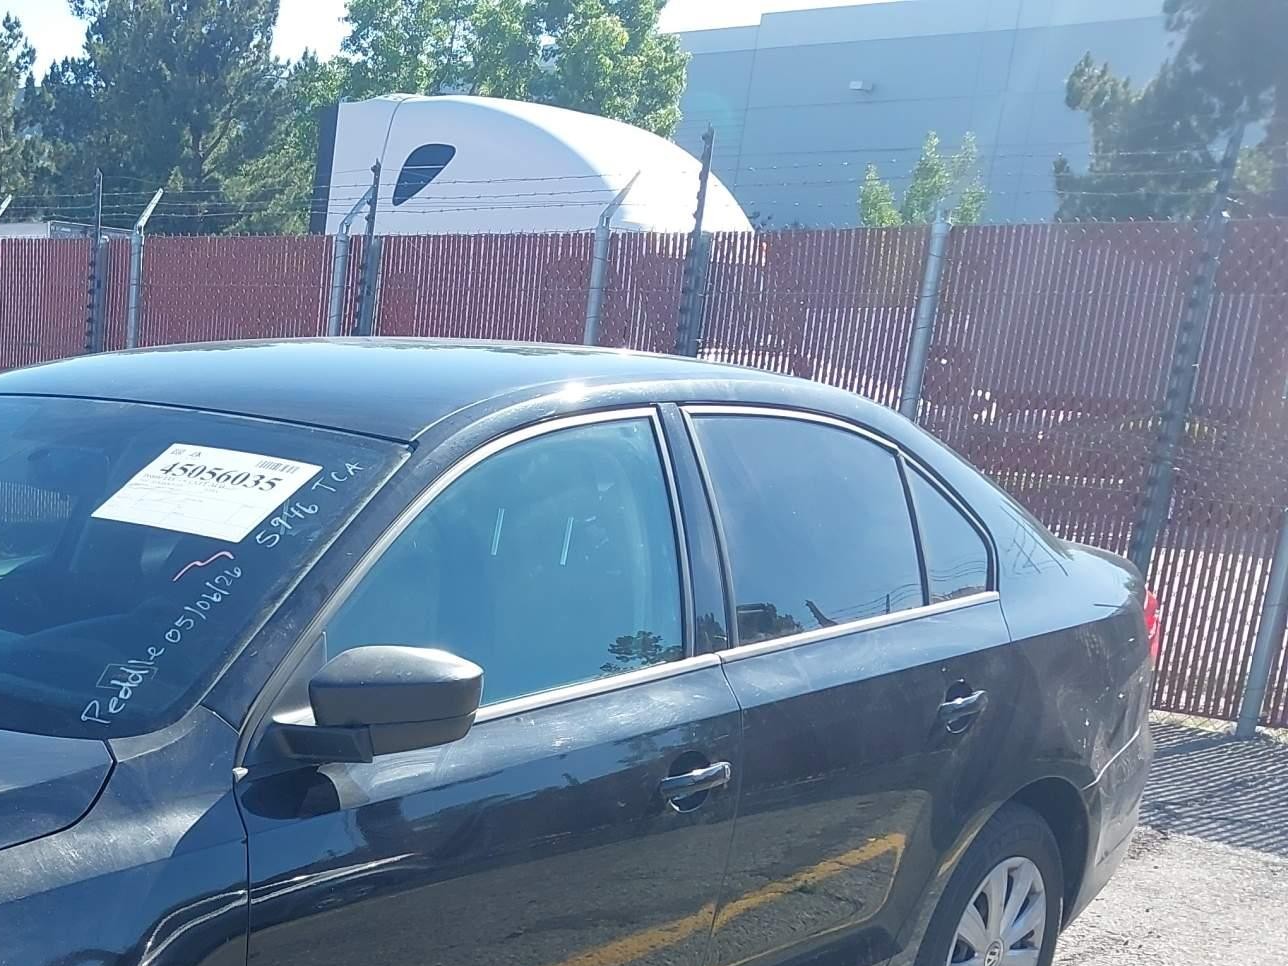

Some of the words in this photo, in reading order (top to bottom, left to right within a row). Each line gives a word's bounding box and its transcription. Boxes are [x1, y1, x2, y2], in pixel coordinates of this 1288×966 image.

[159, 462, 284, 492] 45056035
[165, 566, 243, 643] 05/06/26
[311, 461, 364, 492] TCA
